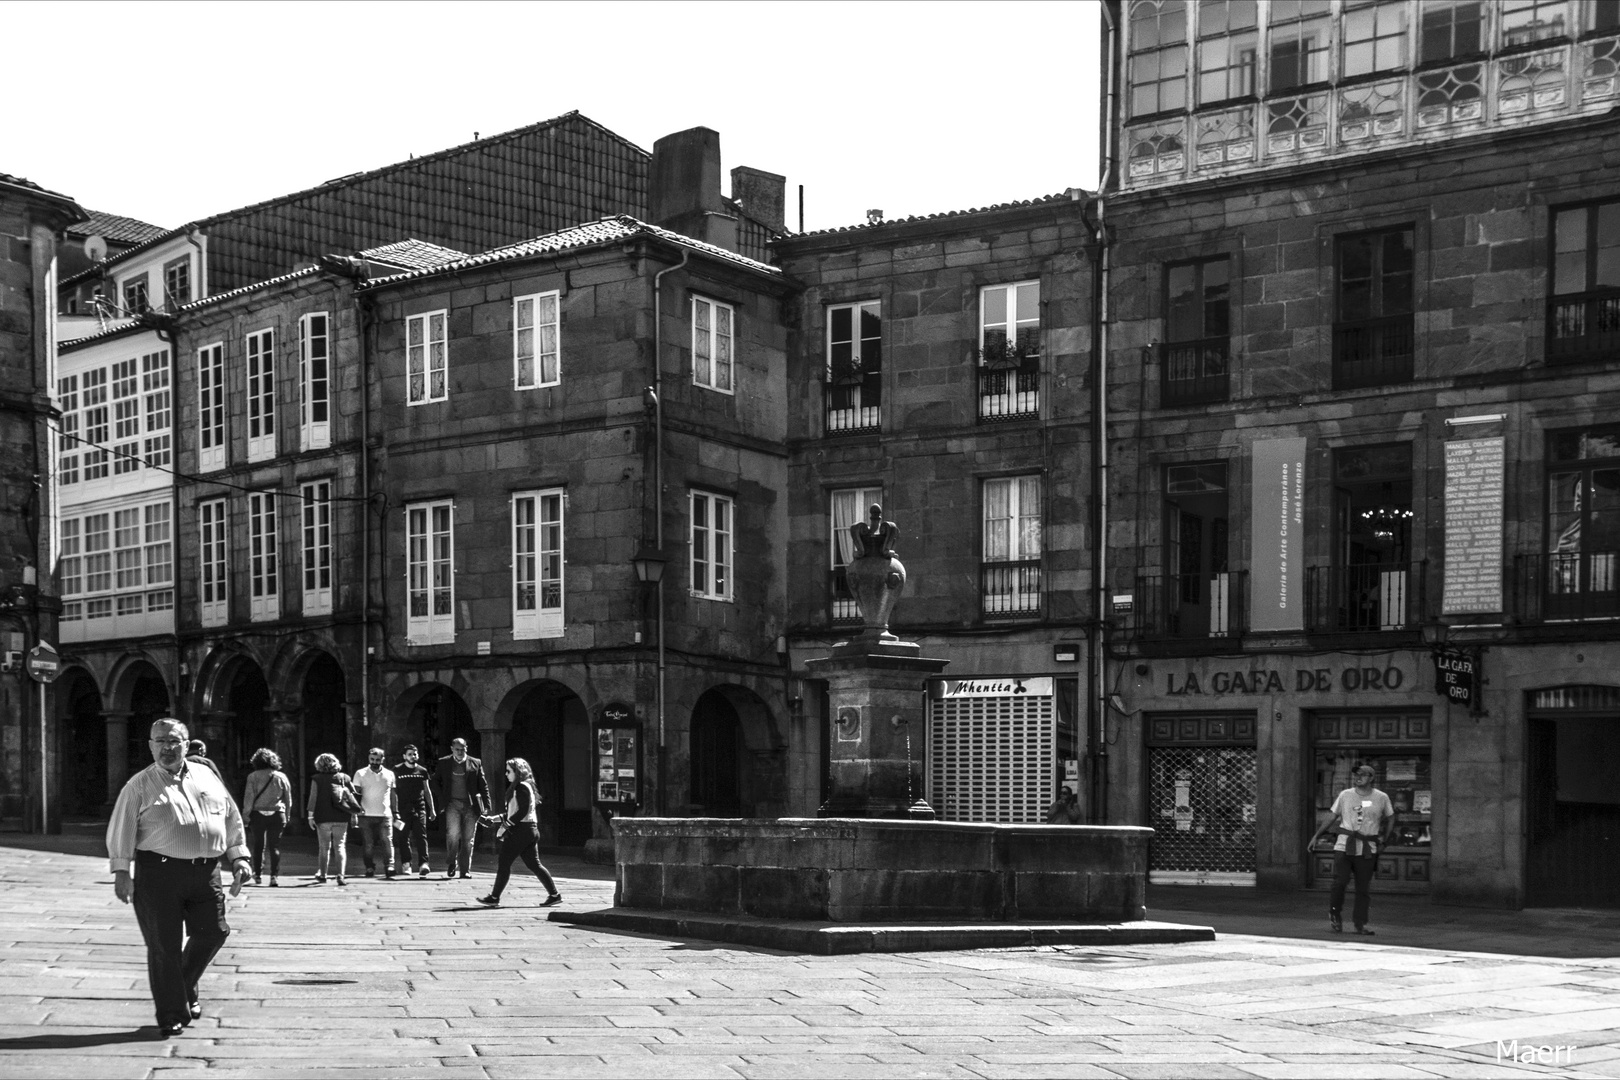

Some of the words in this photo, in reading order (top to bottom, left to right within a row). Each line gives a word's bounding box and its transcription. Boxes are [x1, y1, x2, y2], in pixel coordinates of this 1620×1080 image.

[1294, 462, 1302, 500] Lorenzo
[1280, 463, 1289, 536] Contemporáneo
[1294, 501, 1302, 524] José
[1280, 561, 1287, 573] de
[1438, 657, 1450, 670] LA
[1451, 660, 1473, 674] GAFA
[1166, 672, 1201, 696] LA
[1212, 670, 1285, 693] GAFA
[1296, 668, 1332, 692] DE
[1341, 666, 1404, 690] ORO
[1445, 672, 1458, 684] DE
[952, 680, 1011, 696] Mhentta
[1450, 686, 1468, 699] ORO
[1275, 712, 1282, 721] 9
